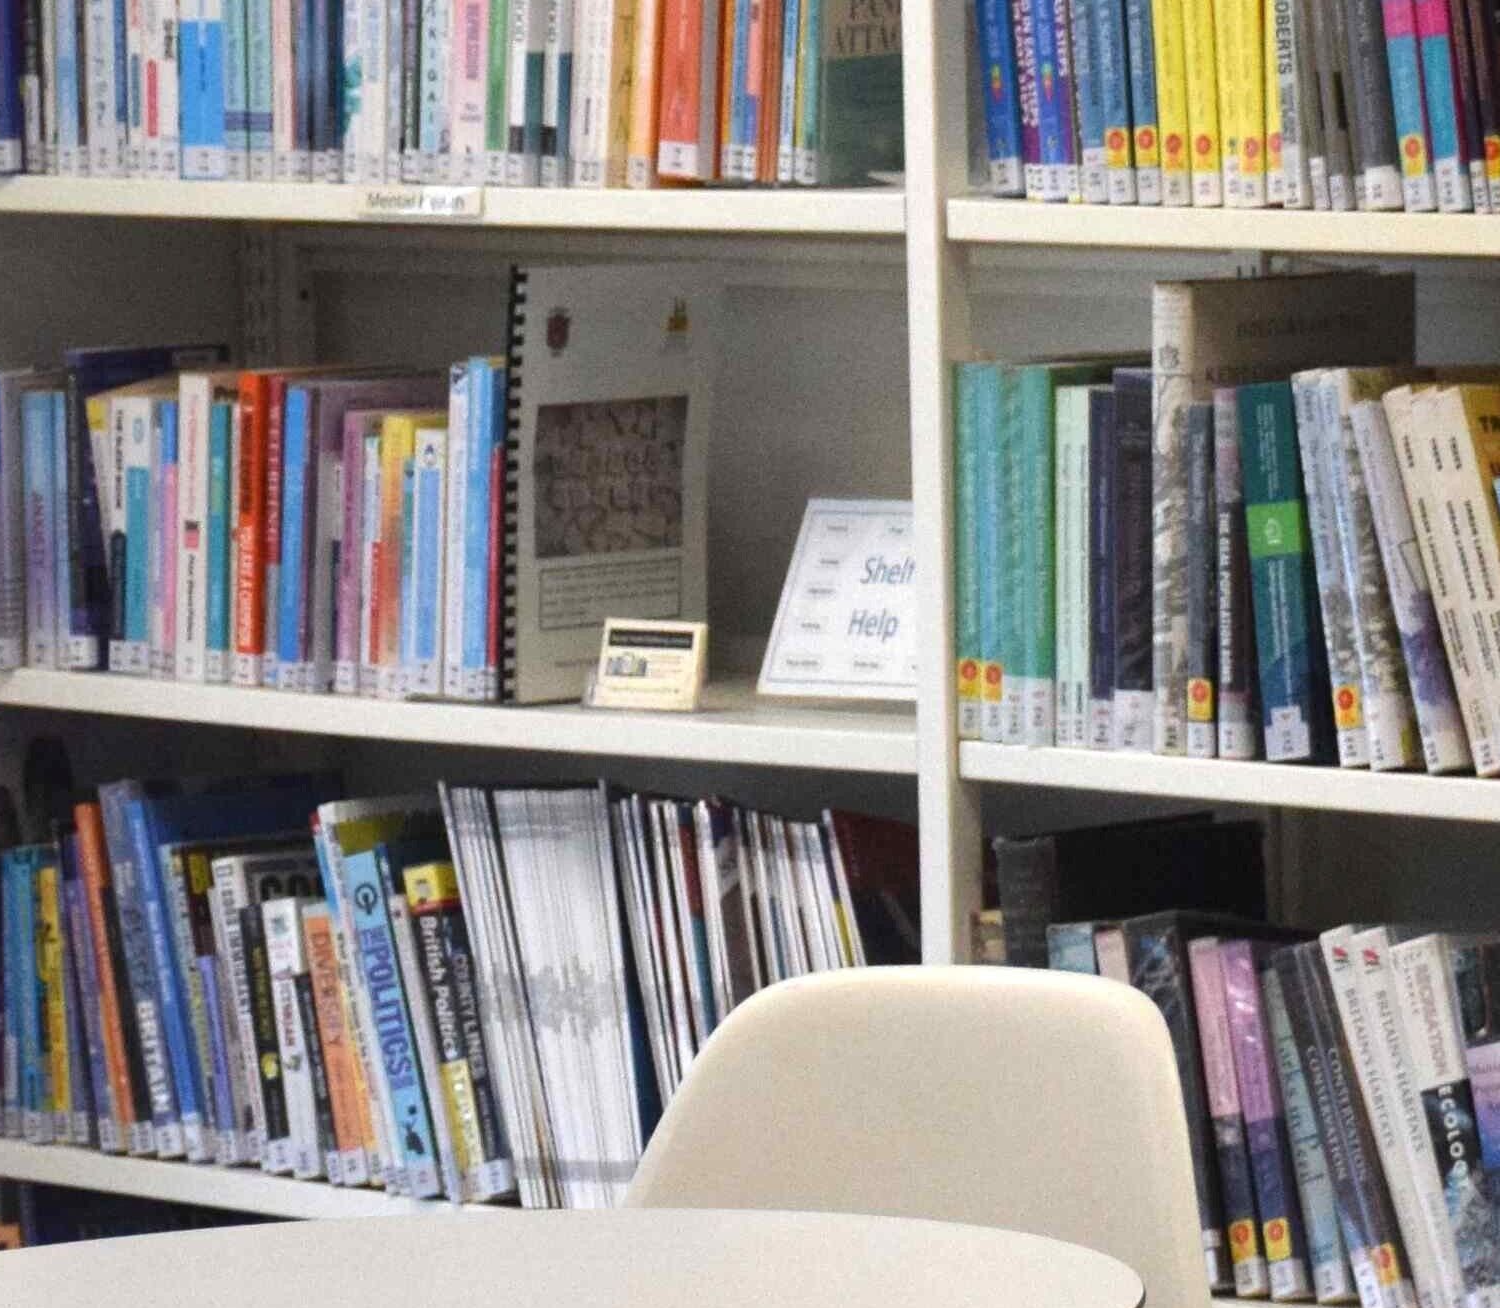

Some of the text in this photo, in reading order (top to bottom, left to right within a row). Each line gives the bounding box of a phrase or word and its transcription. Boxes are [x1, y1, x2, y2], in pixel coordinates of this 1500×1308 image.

[848, 608, 899, 643] Help
[360, 944, 419, 1078] POLITICS
[419, 913, 459, 1059] British Politics
[464, 1021, 486, 1080] LINES
